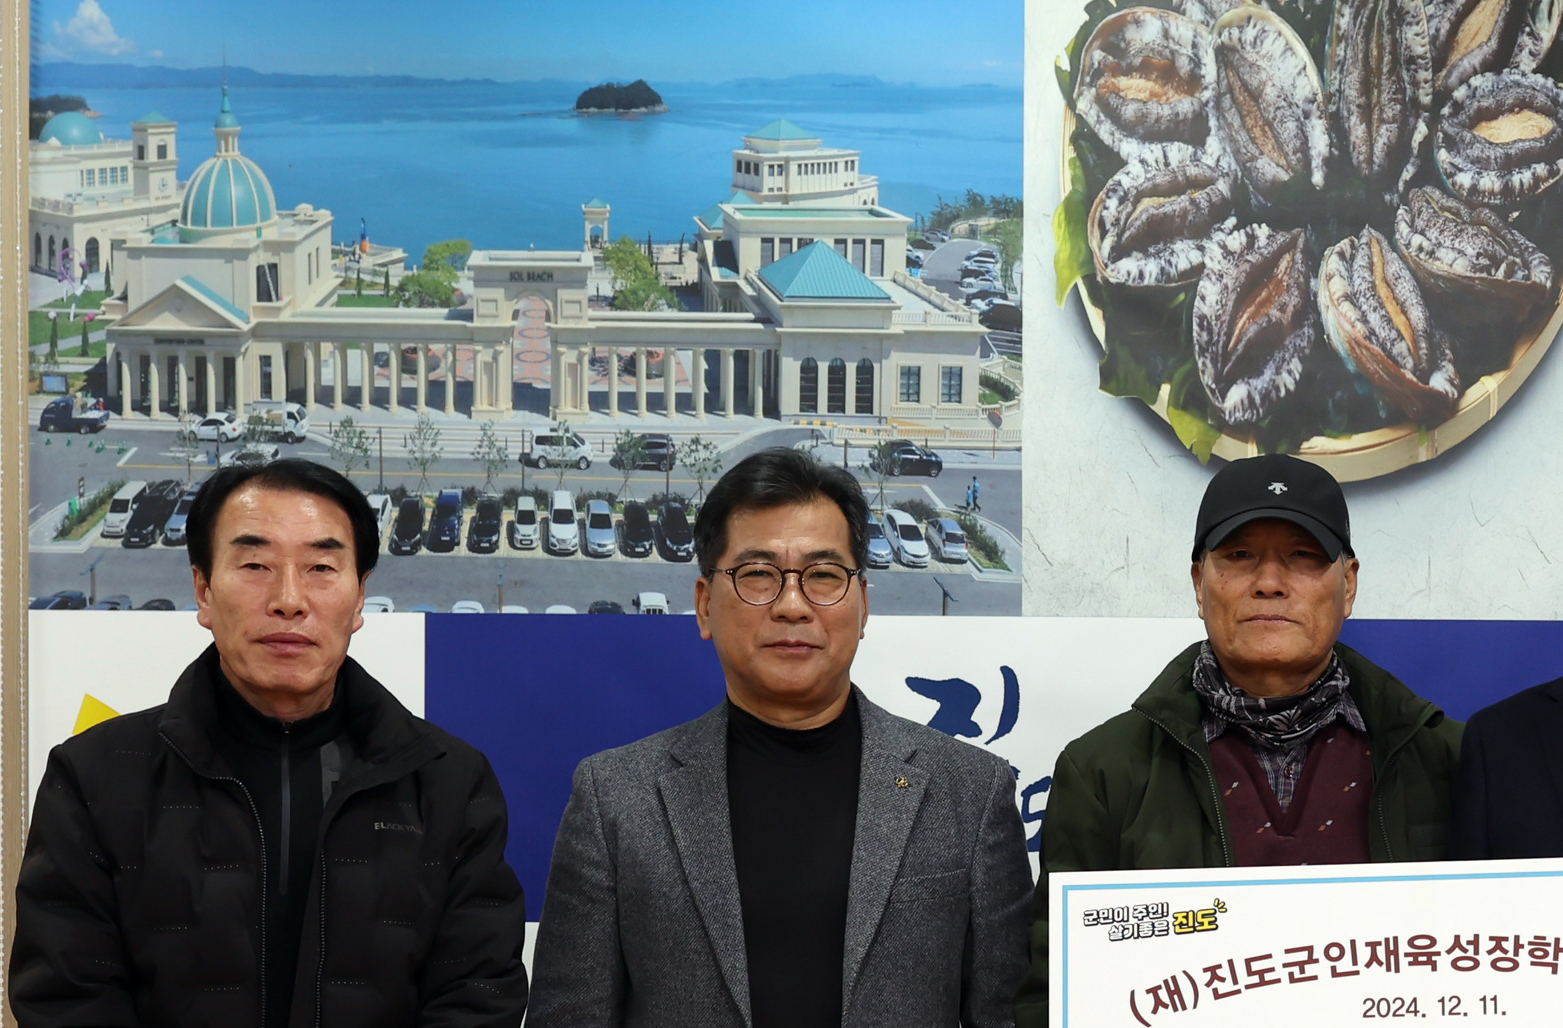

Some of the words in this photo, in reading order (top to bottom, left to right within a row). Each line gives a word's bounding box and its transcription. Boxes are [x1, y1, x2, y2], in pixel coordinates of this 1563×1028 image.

[1083, 905, 1130, 926] 군민이
[1132, 902, 1170, 920] 주인!
[1108, 919, 1170, 942] 살기좋은
[1173, 908, 1219, 934] 진도
[1361, 996, 1428, 1019] 2024.
[1436, 995, 1470, 1017] 12.
[1478, 994, 1508, 1016] 11.
